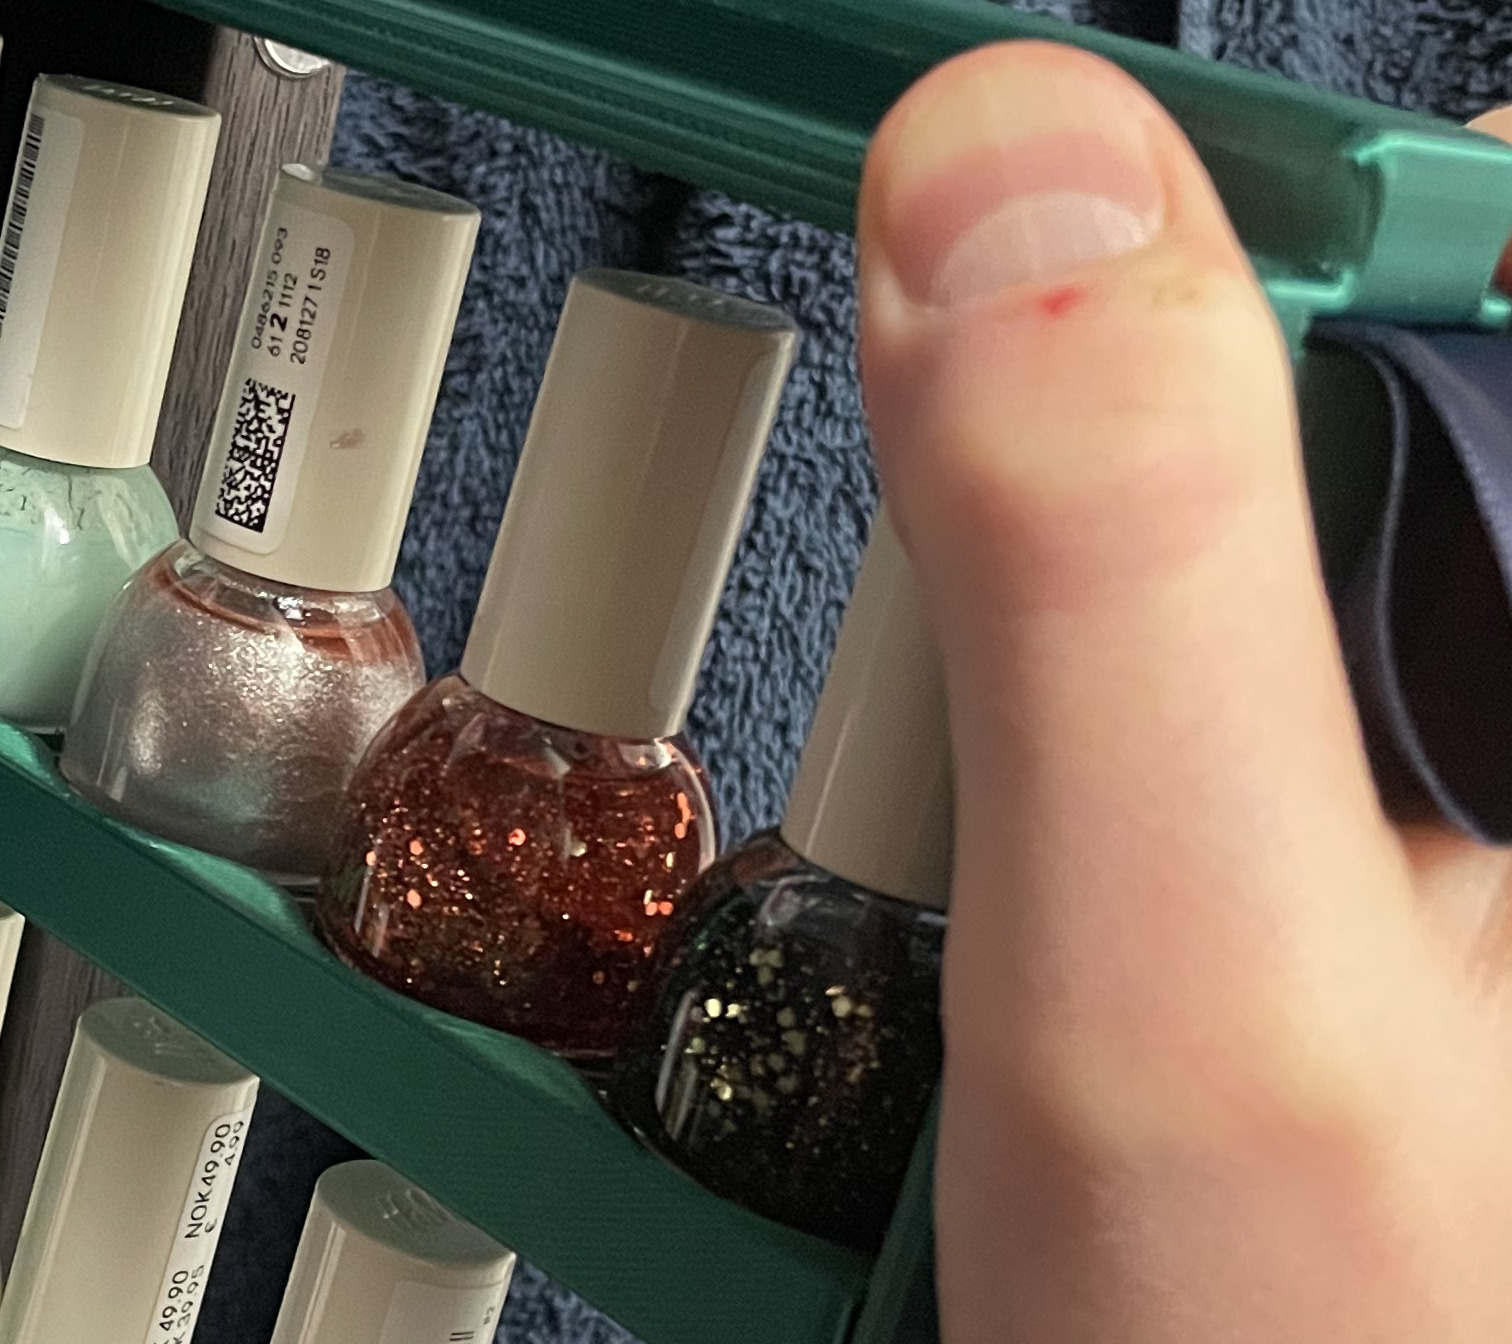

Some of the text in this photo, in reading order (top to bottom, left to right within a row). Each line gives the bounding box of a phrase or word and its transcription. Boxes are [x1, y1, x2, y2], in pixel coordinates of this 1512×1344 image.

[251, 270, 276, 349] 0486215
[269, 313, 287, 329] 2
[279, 274, 296, 306] 1112
[177, 1263, 204, 1327] 39.95
[205, 1216, 217, 1232] €
[224, 1120, 244, 1166] 4.99
[159, 1269, 188, 1330] 49.90
